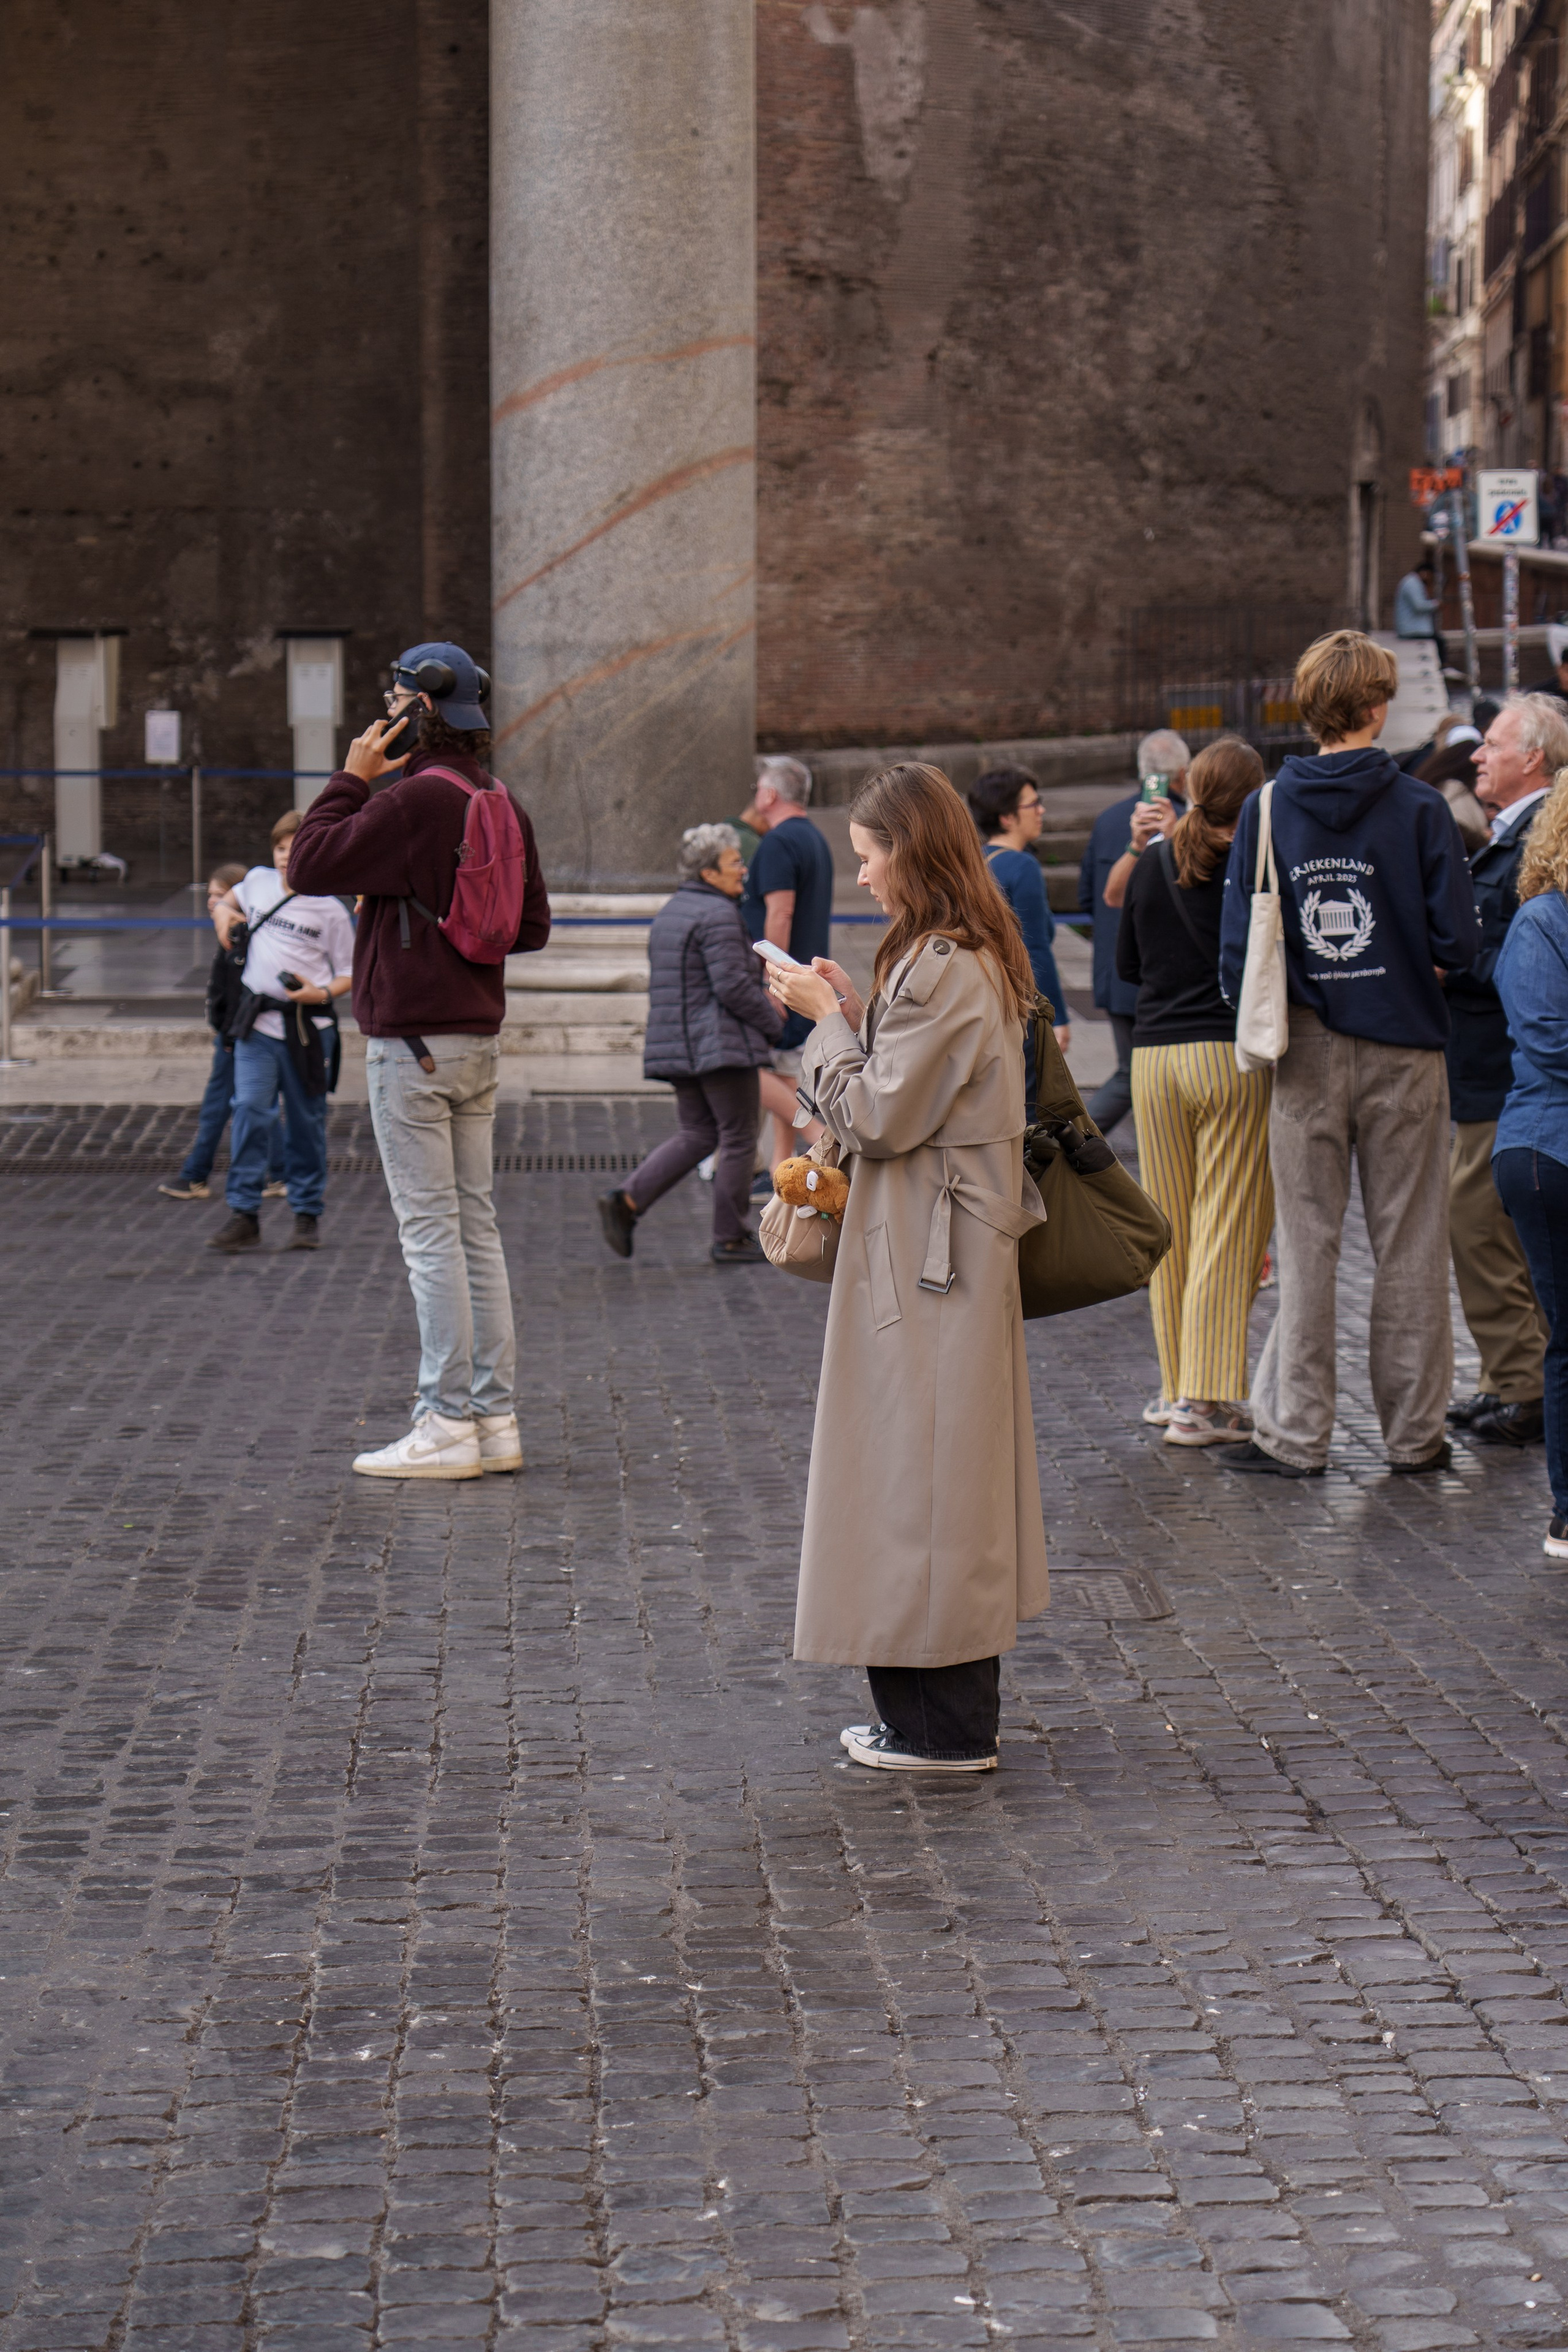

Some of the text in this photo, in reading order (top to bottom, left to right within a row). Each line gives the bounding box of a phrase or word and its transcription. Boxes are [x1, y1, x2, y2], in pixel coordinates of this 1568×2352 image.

[1289, 858, 1374, 882] GRIEKENLAND
[1306, 873, 1358, 886] APRIL 2025
